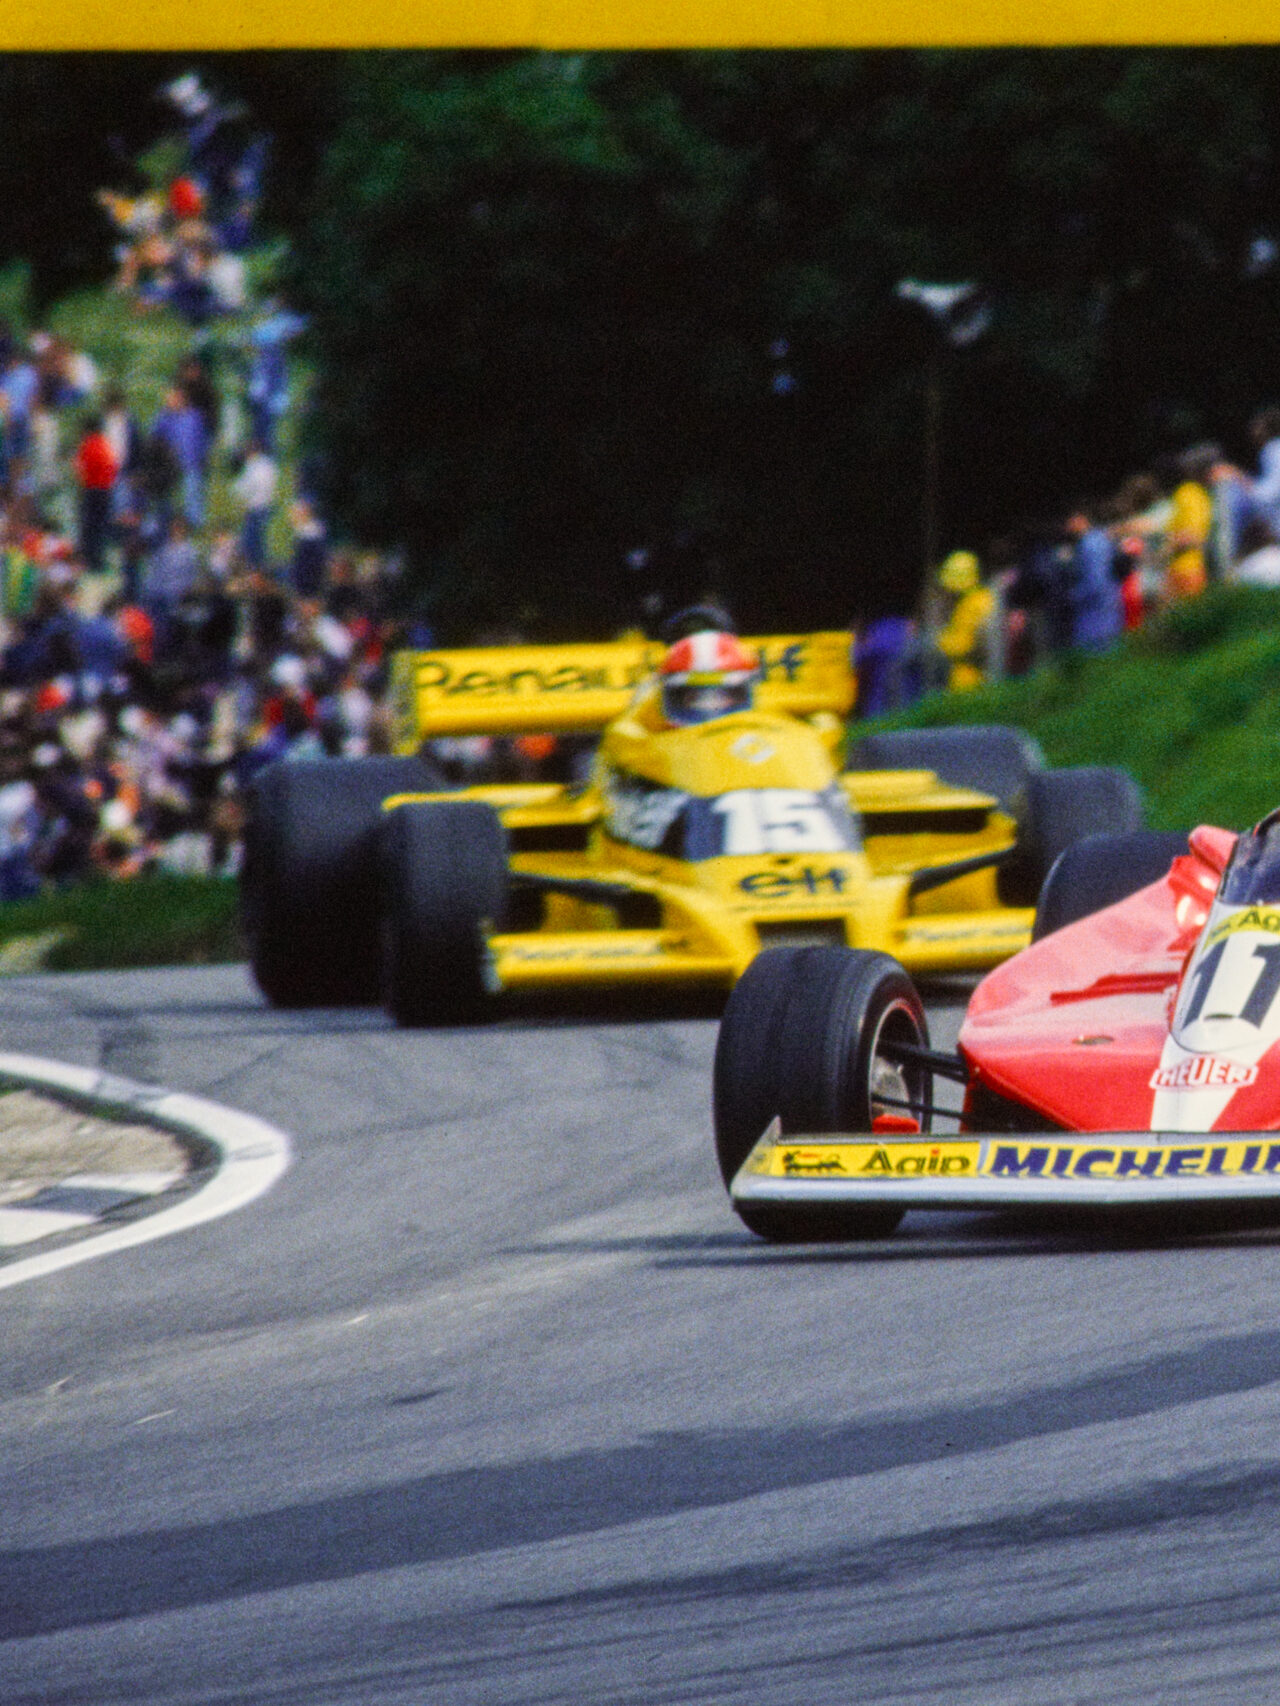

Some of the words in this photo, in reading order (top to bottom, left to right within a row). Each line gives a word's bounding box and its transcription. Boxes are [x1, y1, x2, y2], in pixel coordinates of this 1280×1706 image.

[711, 787, 846, 855] 15
[738, 866, 846, 898] elf
[861, 1147, 971, 1177] Agip
